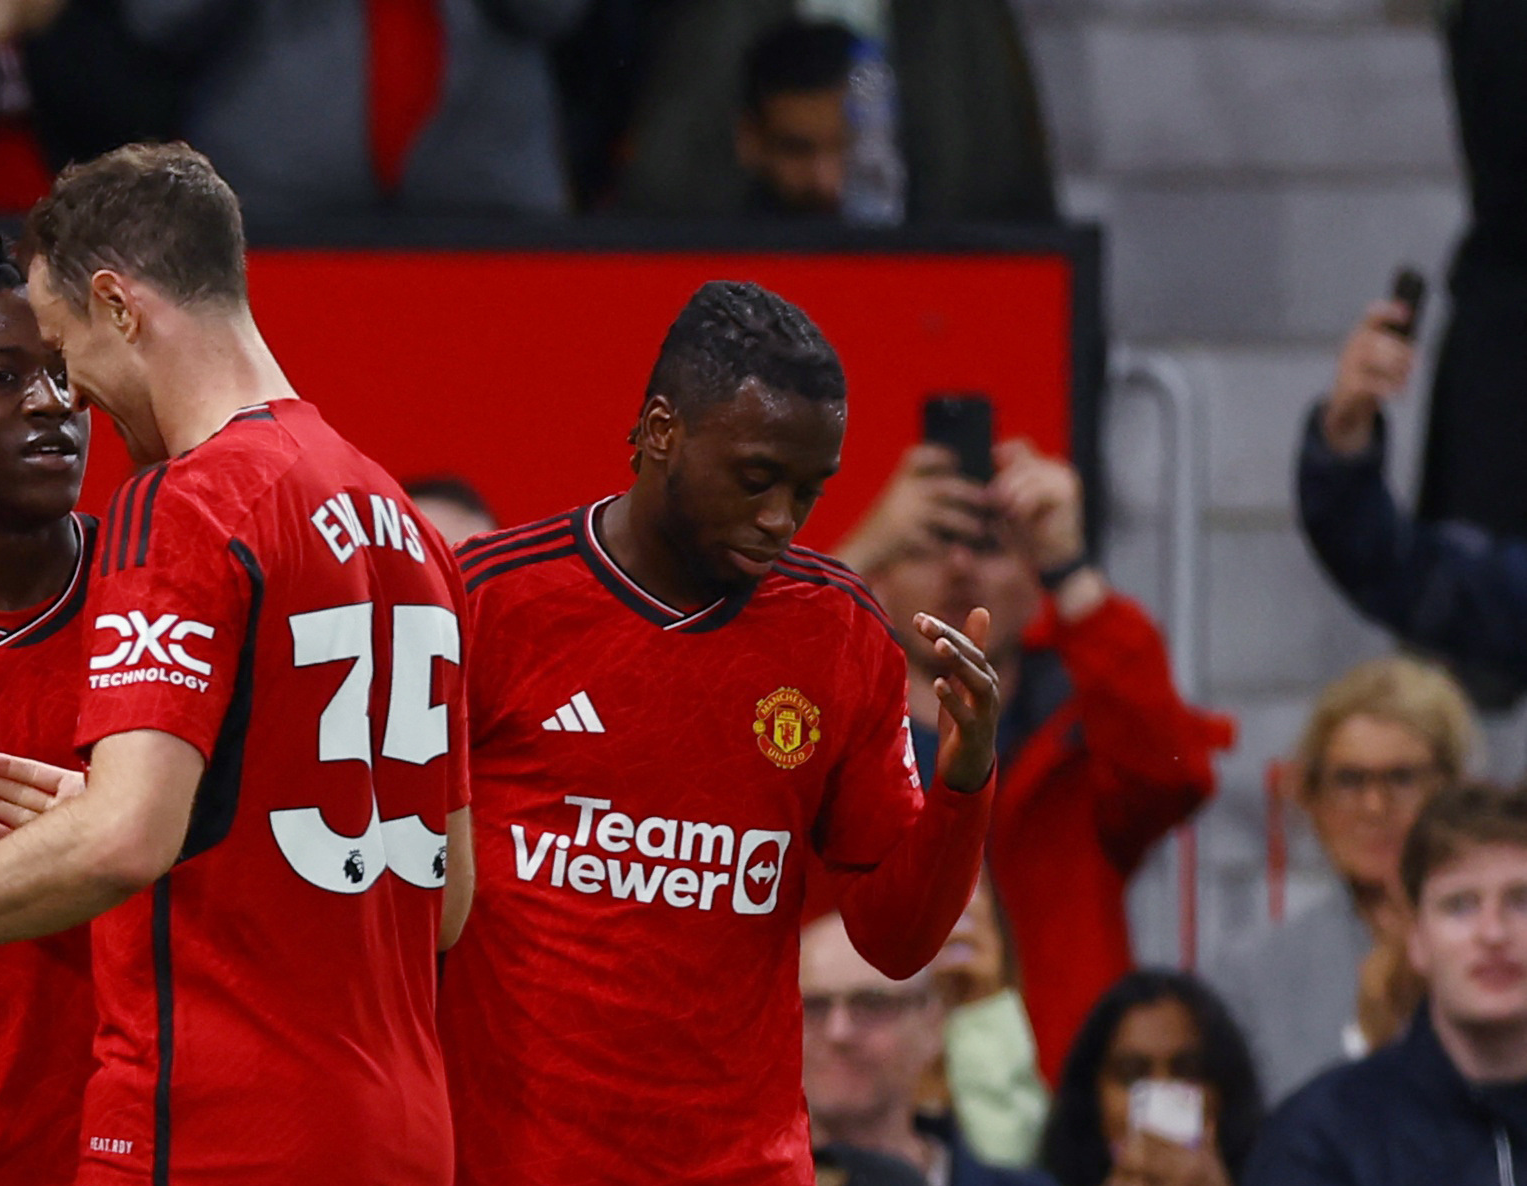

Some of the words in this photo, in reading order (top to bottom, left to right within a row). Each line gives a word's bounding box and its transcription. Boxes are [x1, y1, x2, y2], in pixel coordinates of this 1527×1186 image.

[89, 666, 210, 693] TECHNOLOGY
[269, 601, 460, 895] 35
[510, 823, 732, 911] Viewer
[564, 795, 736, 866] Team
